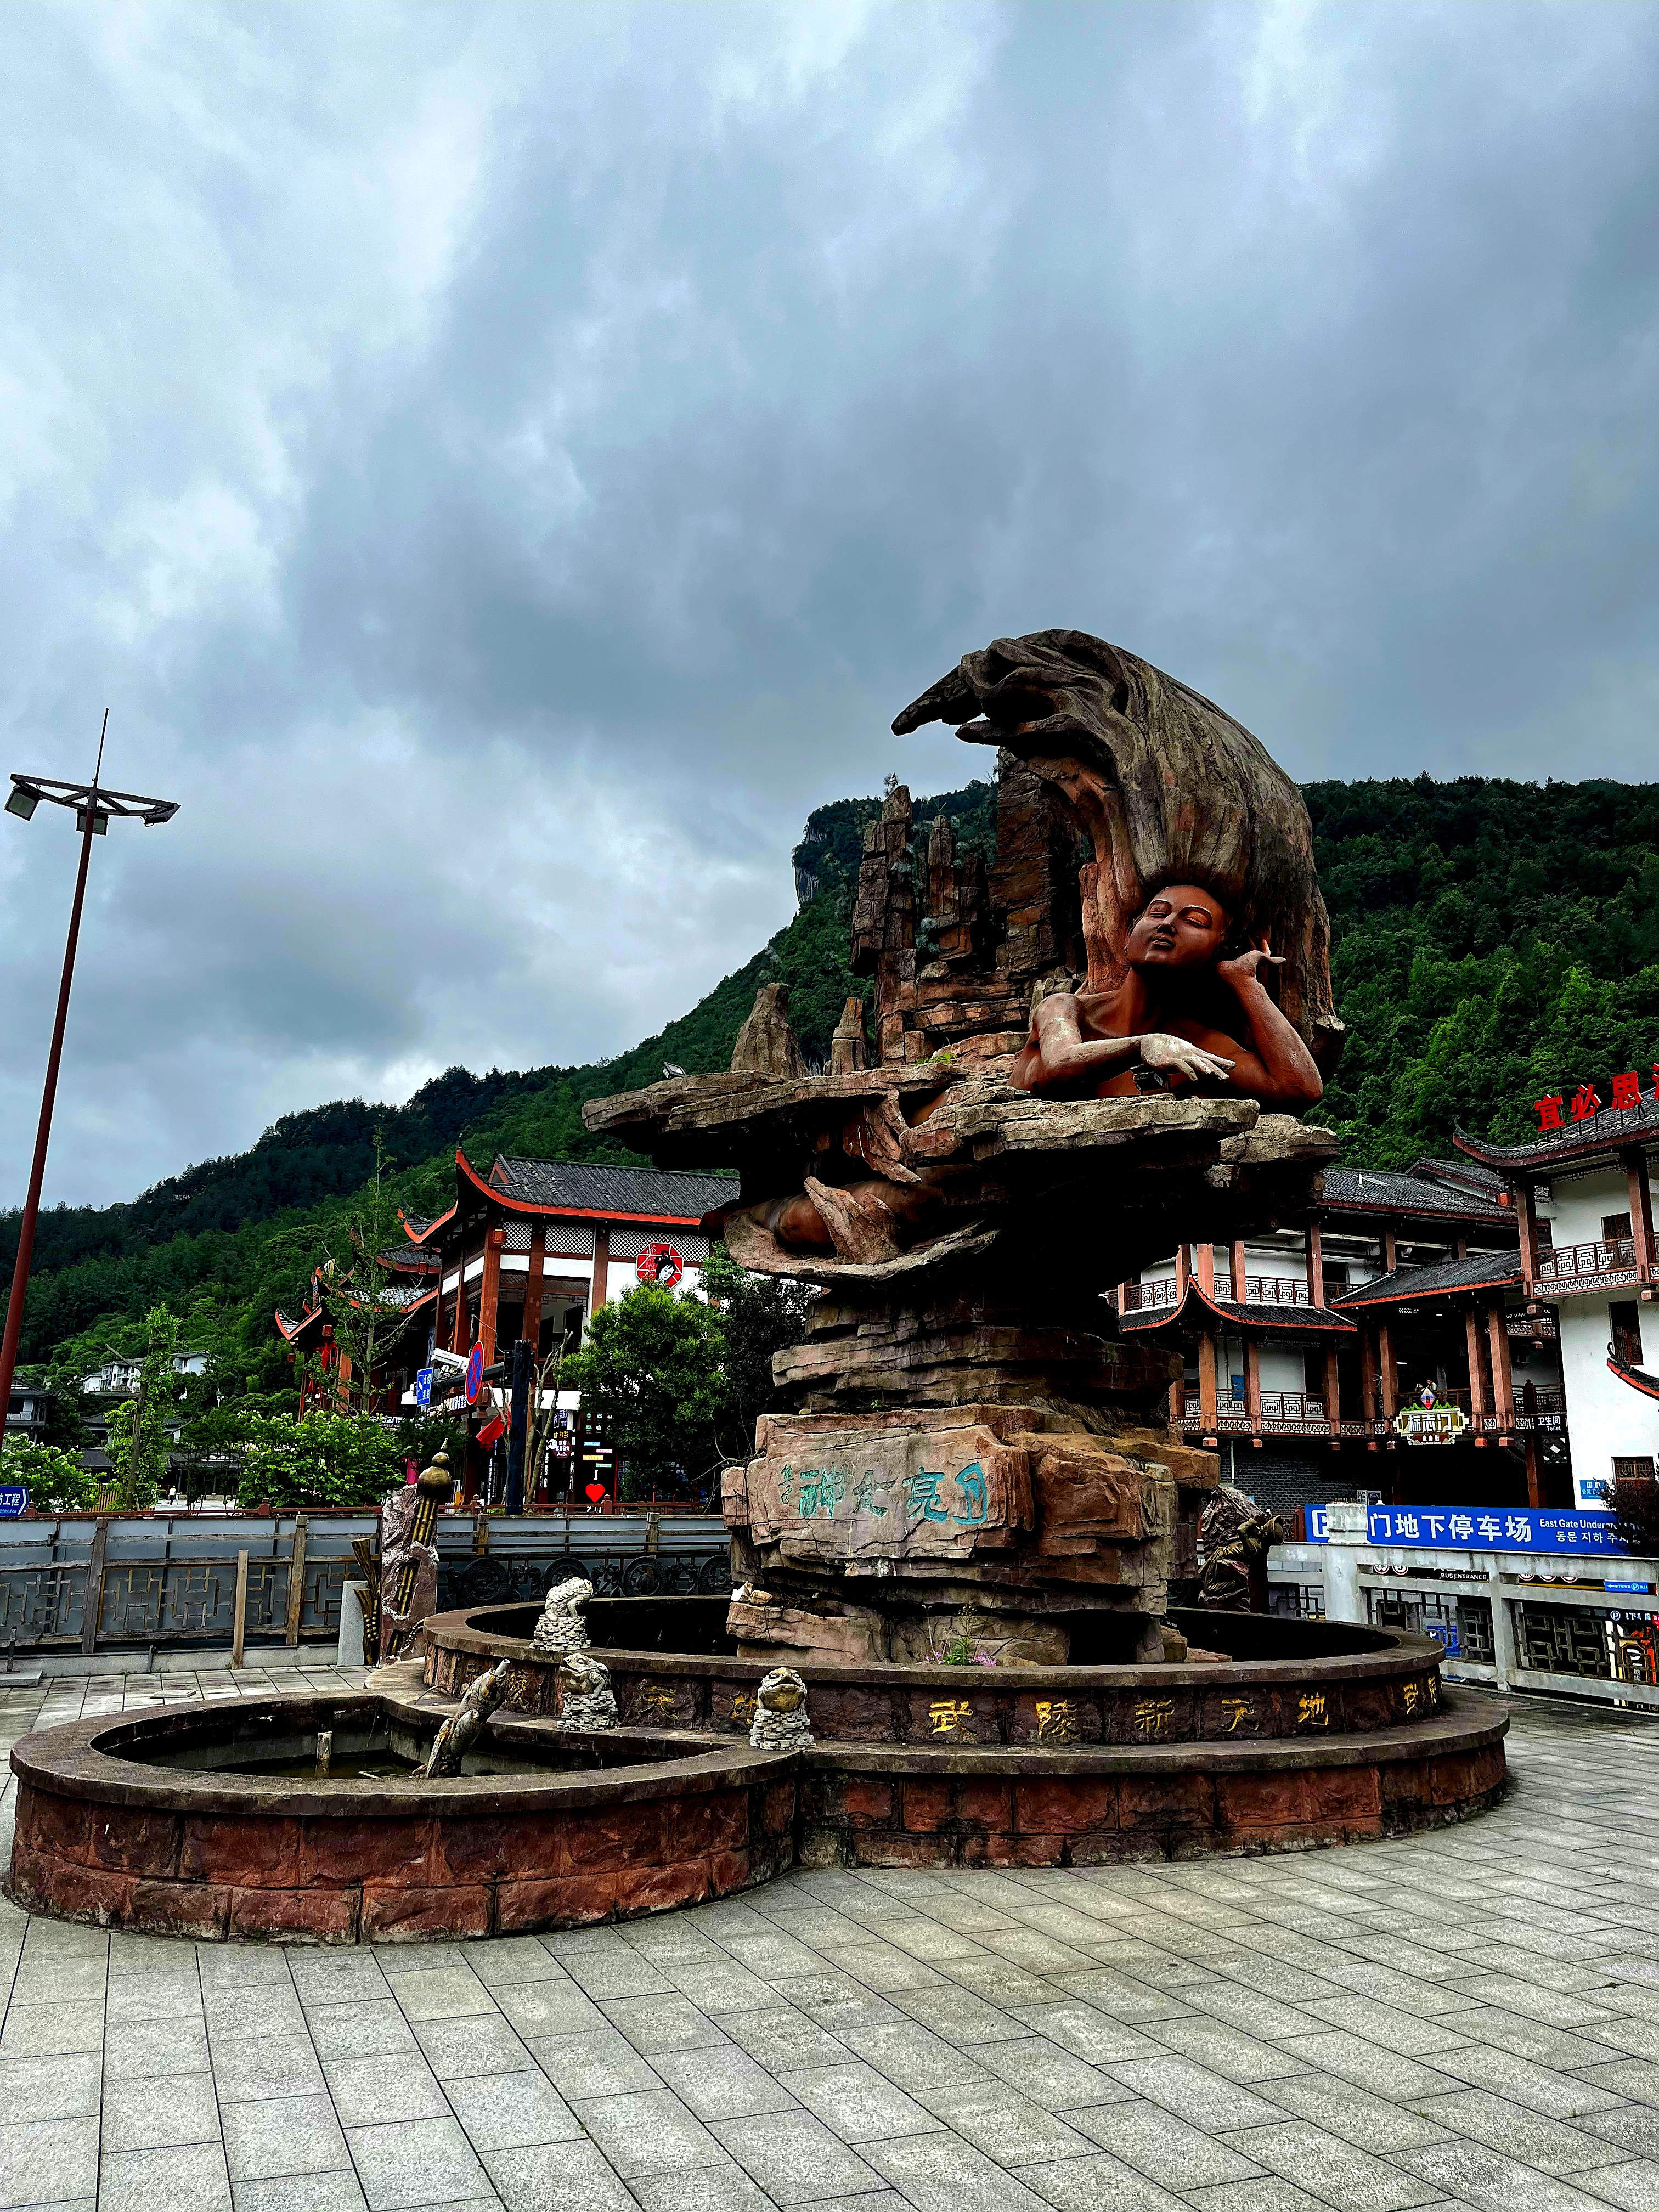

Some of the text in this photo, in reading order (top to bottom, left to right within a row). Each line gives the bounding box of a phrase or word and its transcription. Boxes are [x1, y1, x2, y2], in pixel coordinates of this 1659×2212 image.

[1534, 1063, 1659, 1132] 宜必思
[1408, 1414, 1452, 1432] 标志门
[1537, 1415, 1561, 1426] 卫生间
[1539, 1518, 1558, 1528] East
[1559, 1519, 1578, 1528] Gate
[1556, 1531, 1578, 1542] 동문
[1581, 1531, 1604, 1543] 지하
